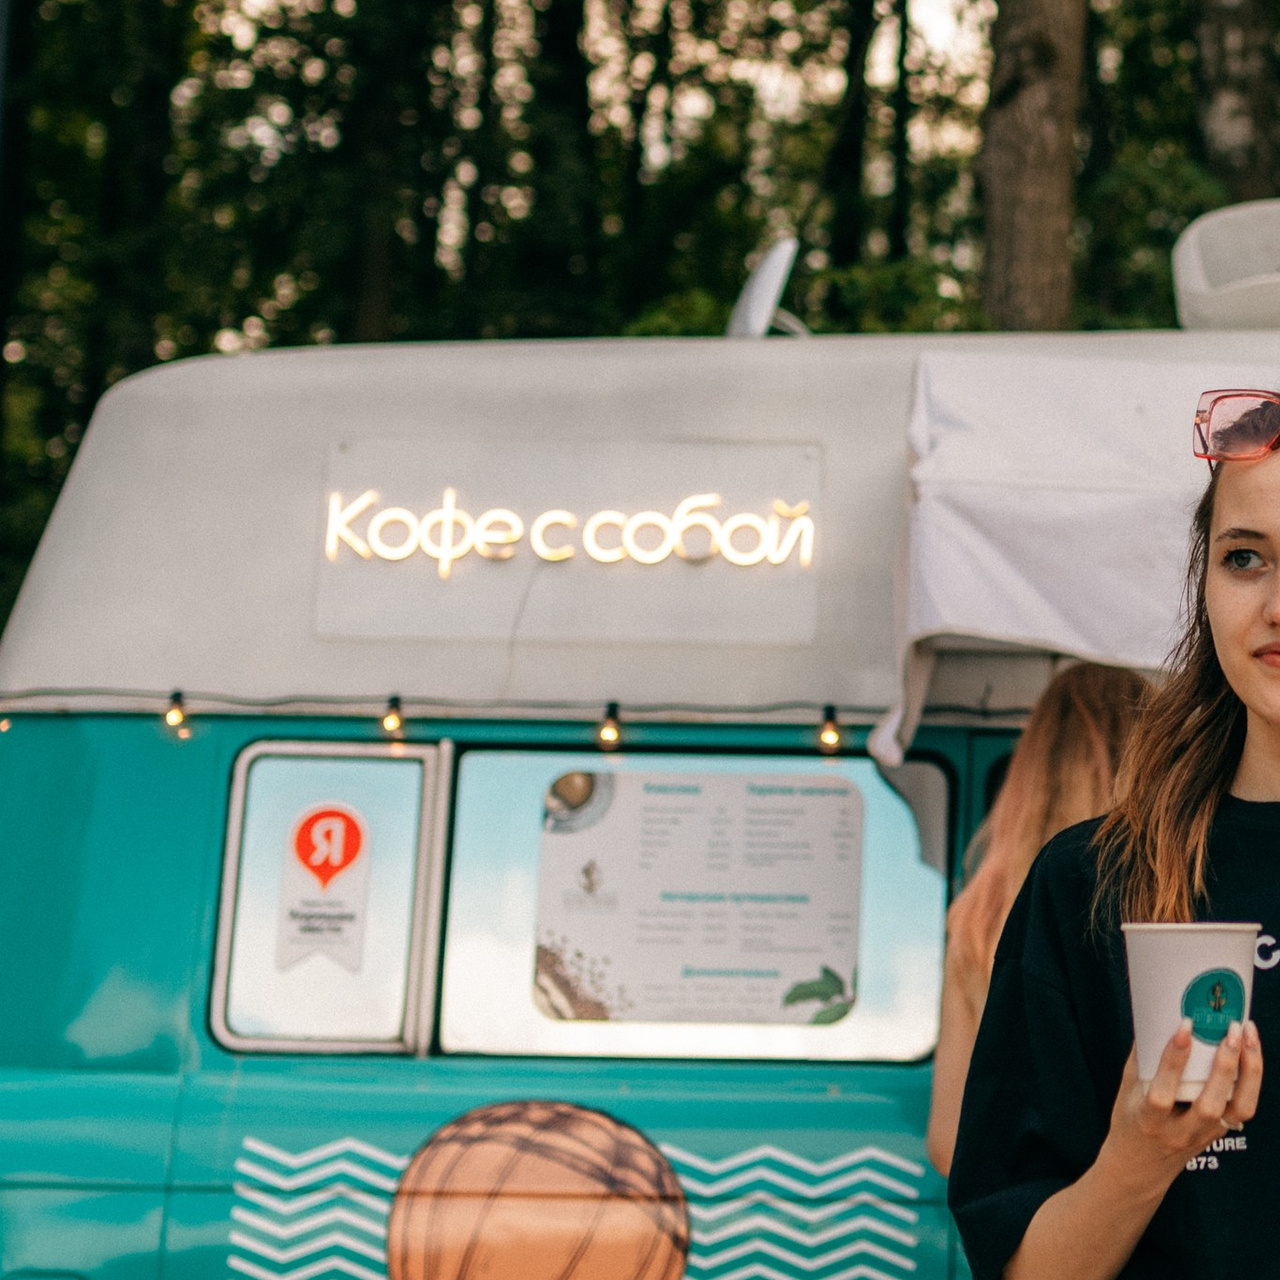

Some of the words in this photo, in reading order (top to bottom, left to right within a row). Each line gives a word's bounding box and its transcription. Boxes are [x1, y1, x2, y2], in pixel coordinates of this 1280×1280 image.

[325, 487, 524, 579] Кофе
[530, 509, 577, 561] с
[583, 492, 815, 567] собой
[310, 818, 345, 867] Я
[1186, 1156, 1219, 1171] 873
